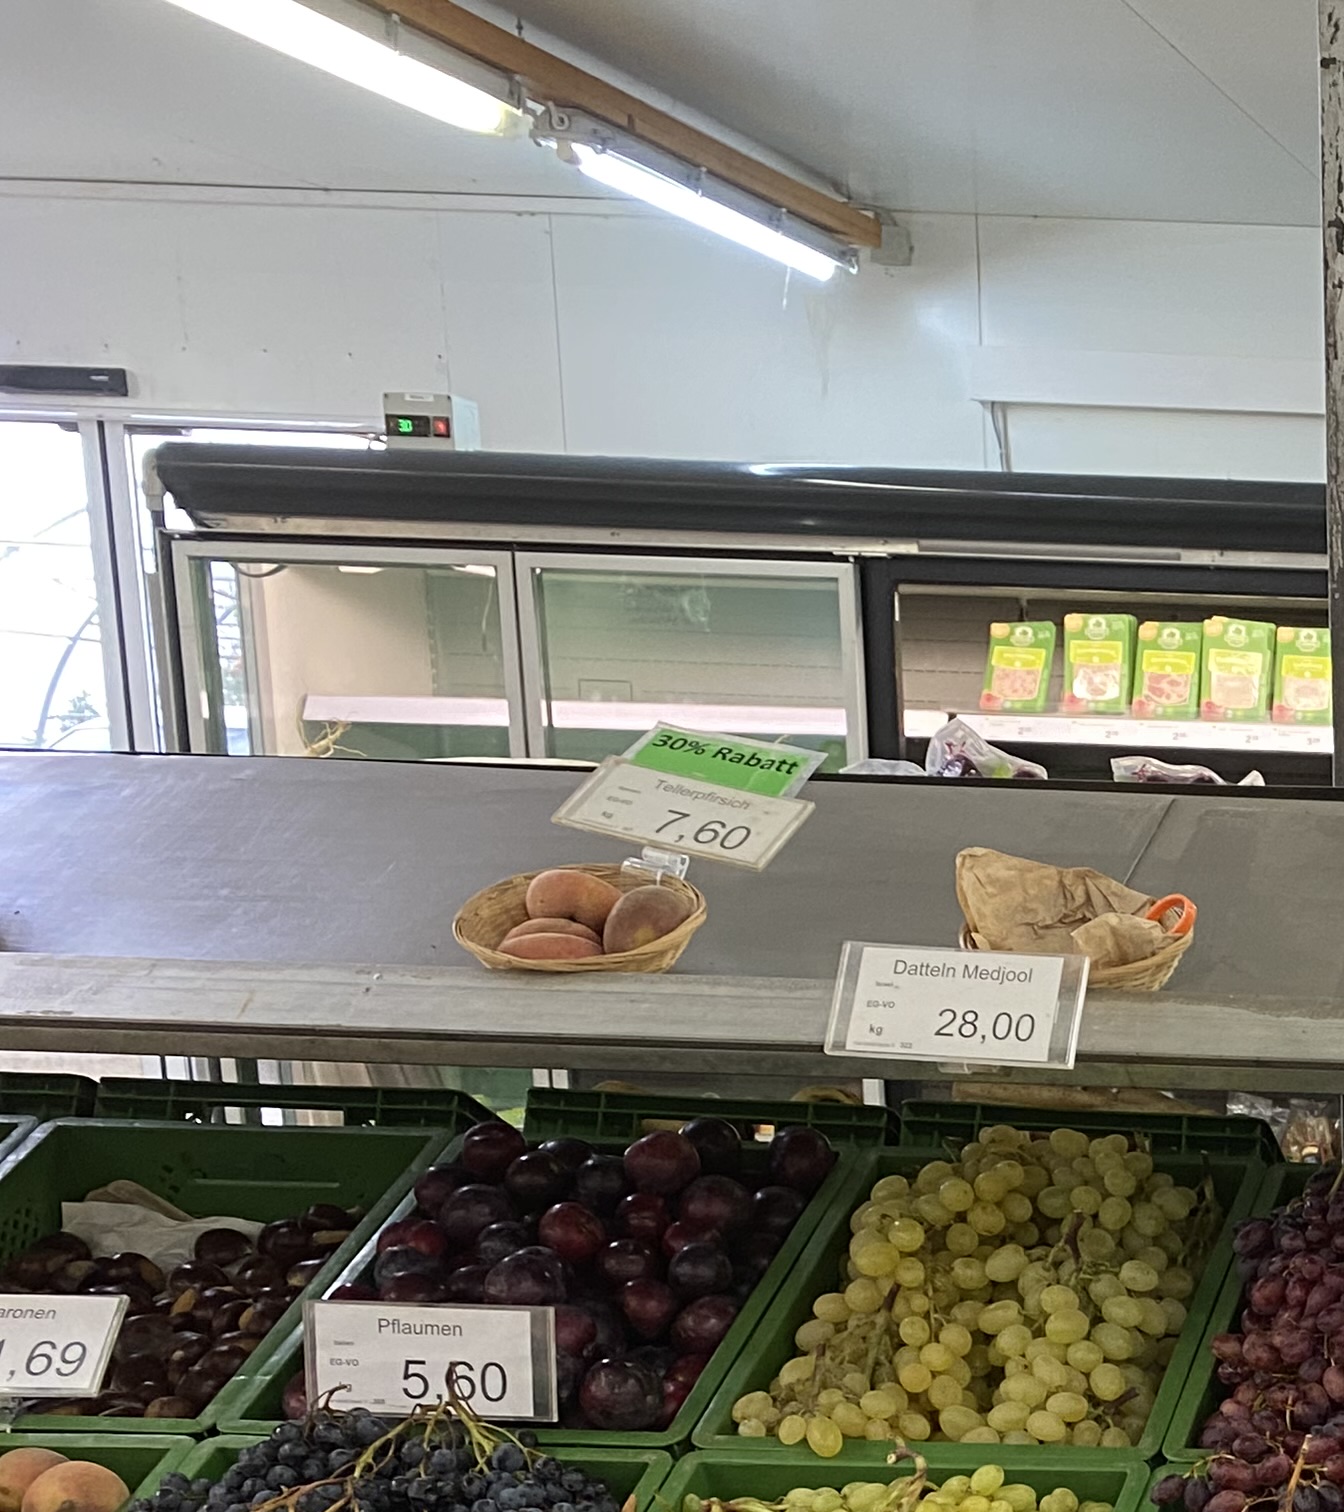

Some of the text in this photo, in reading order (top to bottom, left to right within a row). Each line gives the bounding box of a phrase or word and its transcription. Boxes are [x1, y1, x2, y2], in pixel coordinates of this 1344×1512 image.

[652, 734, 799, 775] 30% Rabatt
[655, 779, 750, 810] Tellerpfirsich
[654, 809, 751, 850] 7,60
[893, 960, 1033, 984] Datteln Medjool
[869, 1024, 883, 1036] kg
[934, 1008, 1035, 1044] 28,00
[377, 1319, 463, 1337] Pflaumen
[329, 1358, 359, 1367] EG-VO
[402, 1359, 507, 1403] 5,60
